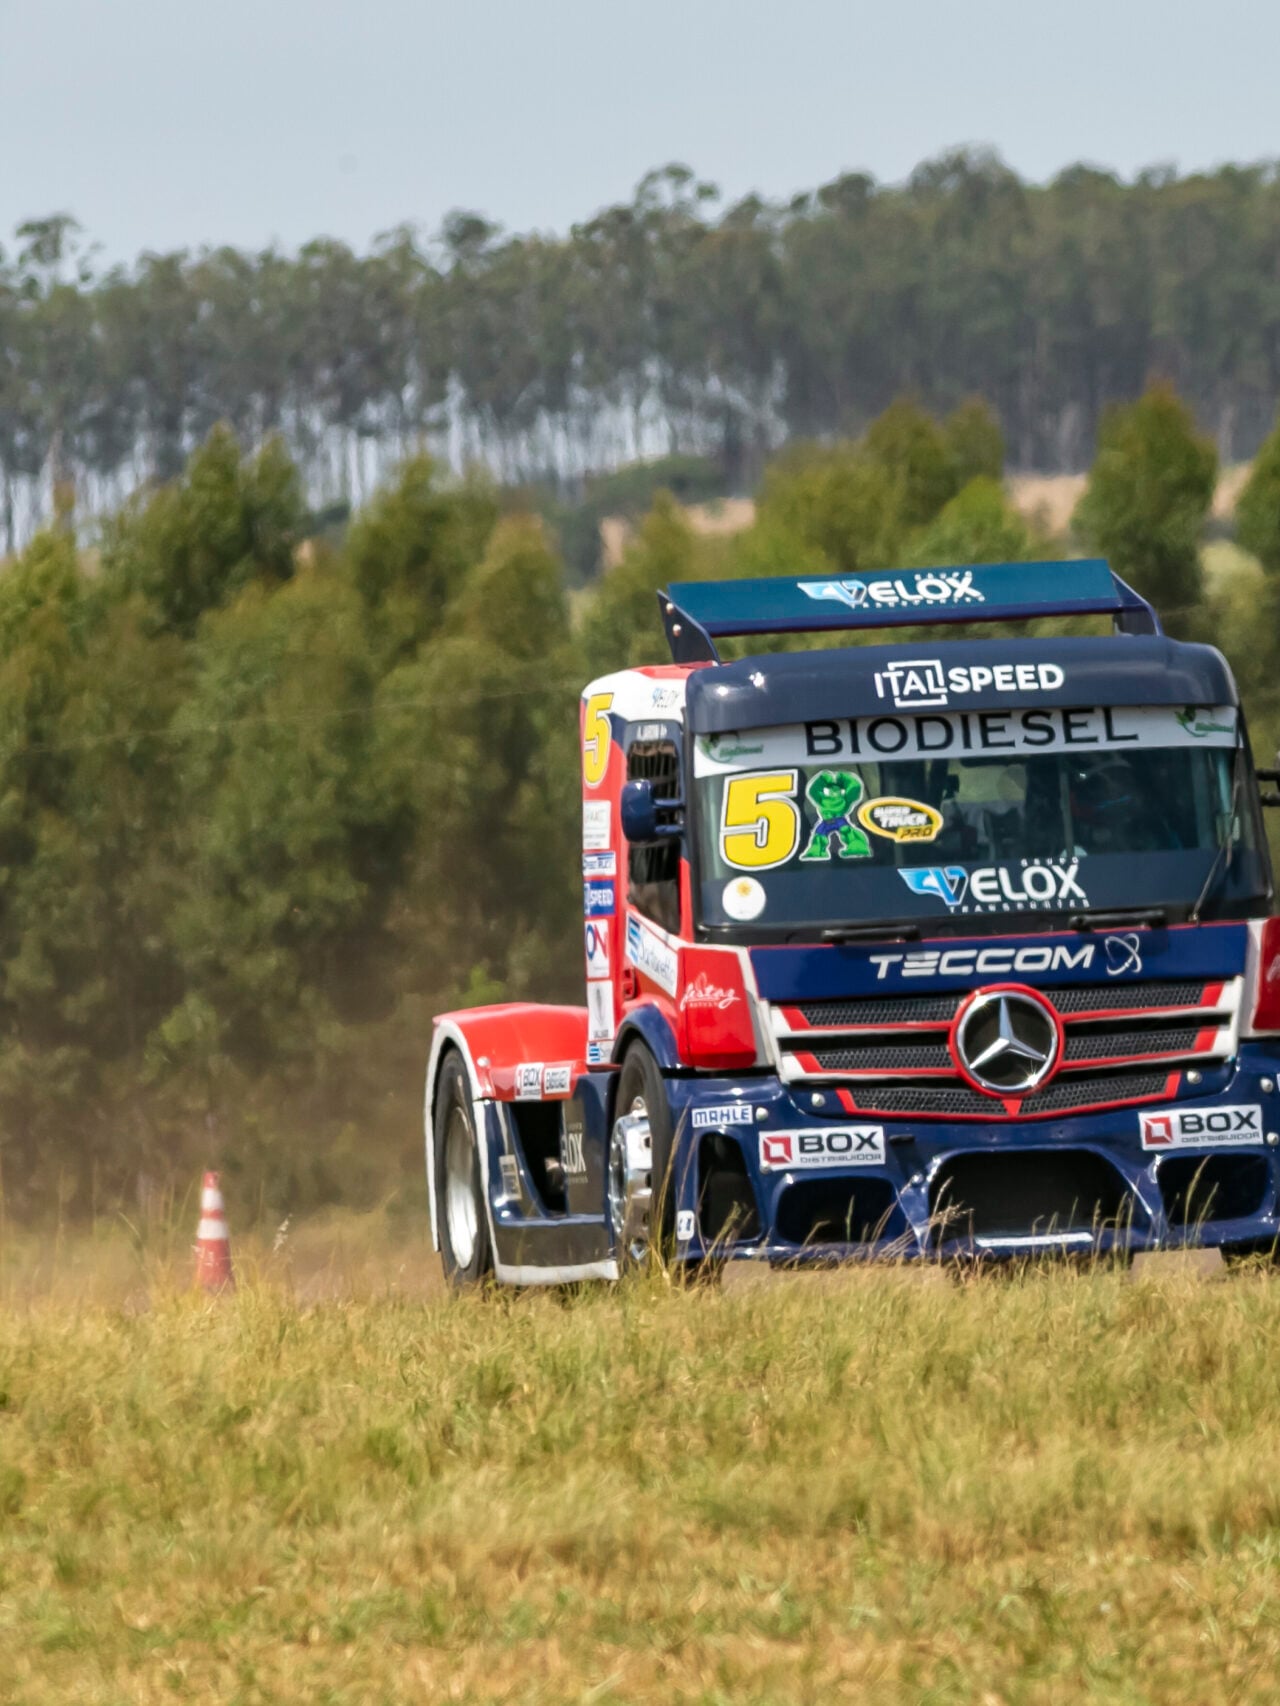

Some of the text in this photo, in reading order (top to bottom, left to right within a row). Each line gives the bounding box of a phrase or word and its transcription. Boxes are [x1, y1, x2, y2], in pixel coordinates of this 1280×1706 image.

[839, 578, 982, 606] VELOX
[584, 692, 615, 788] 5
[805, 707, 1139, 758] BIODIESEL
[719, 769, 801, 871] 5
[899, 826, 933, 839] PRO
[932, 863, 1087, 906] VELOX
[869, 944, 1096, 979] TECCOM
[694, 1108, 751, 1126] MAHLE
[1179, 1110, 1258, 1134] BOX
[798, 1131, 880, 1154] BOX
[1180, 1132, 1260, 1143] DISTRIBUIDOR
[799, 1153, 882, 1164] DISTRIBUIDOR
